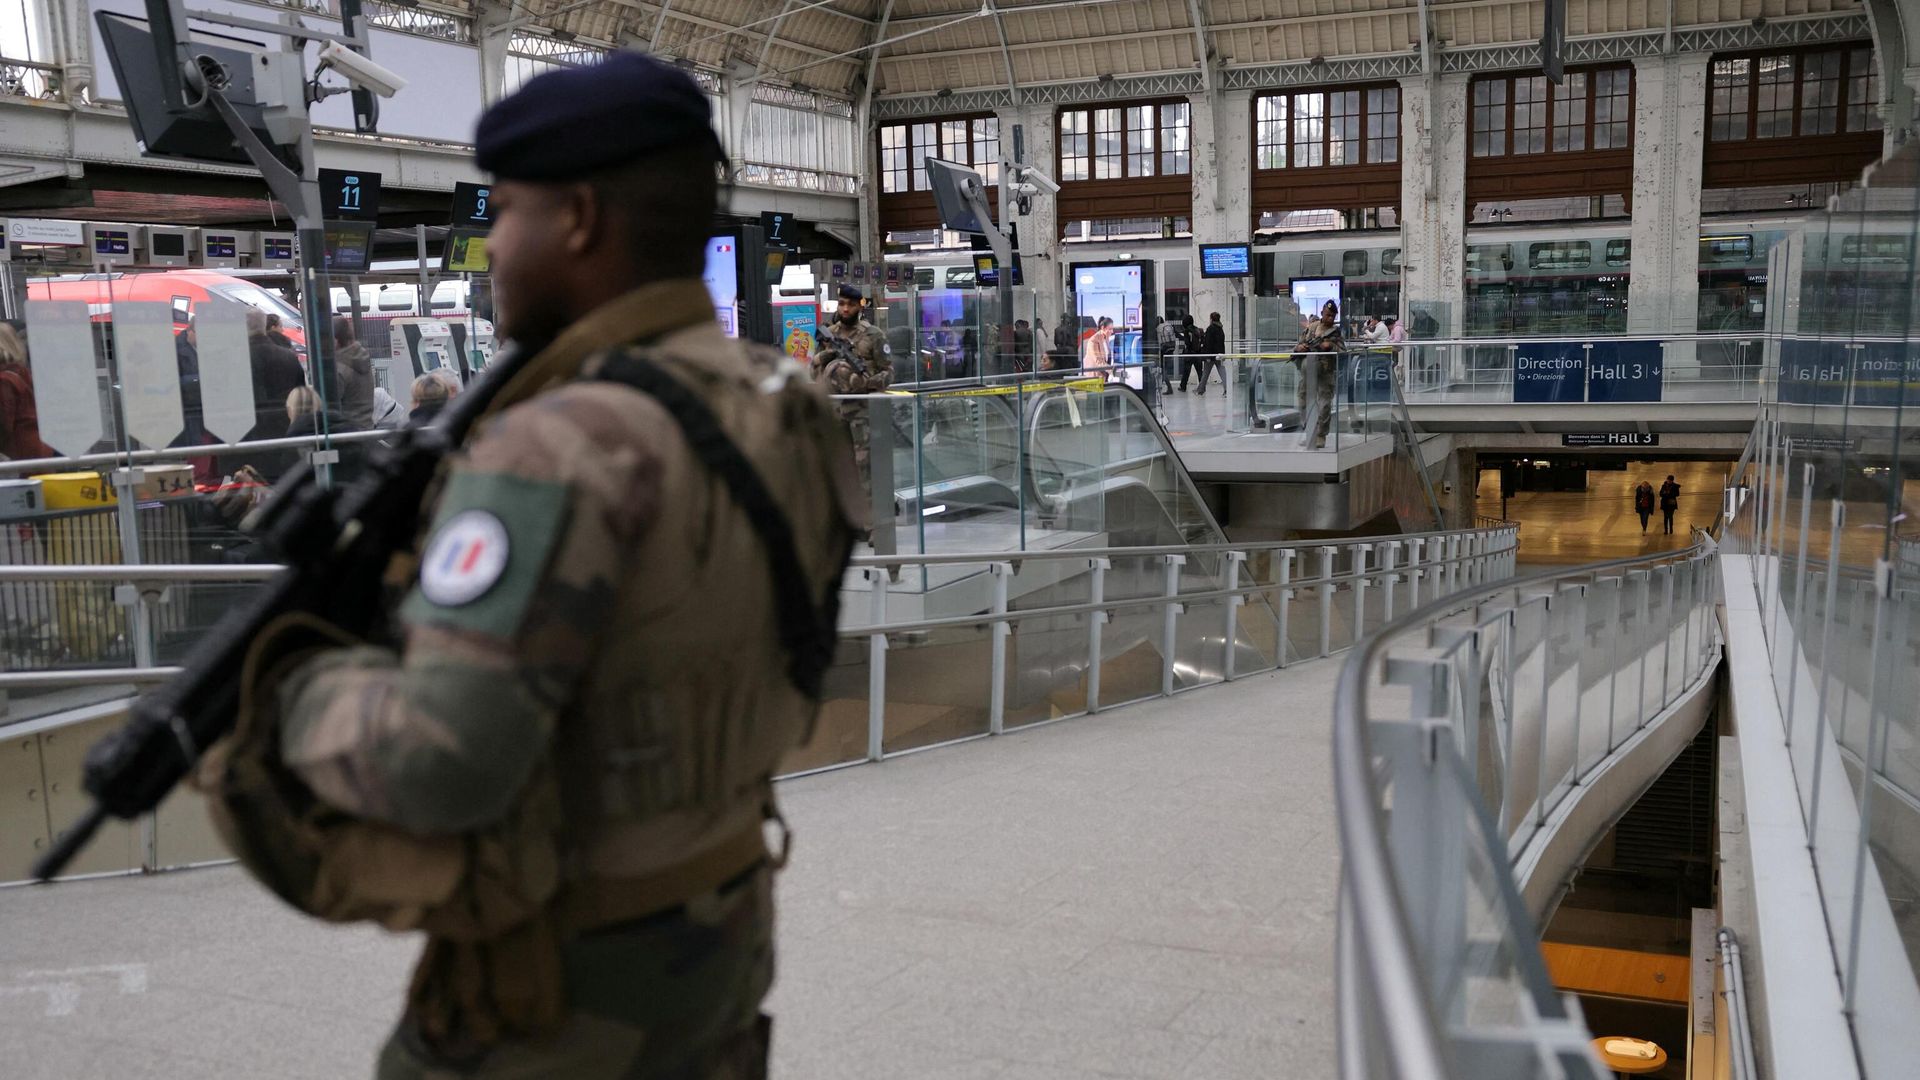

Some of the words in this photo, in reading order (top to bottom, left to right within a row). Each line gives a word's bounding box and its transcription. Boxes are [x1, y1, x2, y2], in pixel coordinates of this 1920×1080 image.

[342, 186, 360, 206] 11
[476, 198, 486, 216] 9
[774, 223, 781, 237] 7
[1518, 357, 1582, 370] Direction
[1518, 373, 1526, 381] To
[1532, 373, 1566, 381] Direzione
[1591, 364, 1627, 380] Hall
[1631, 364, 1642, 380] 3
[1608, 433, 1639, 443] Hall
[1643, 433, 1652, 443] 3
